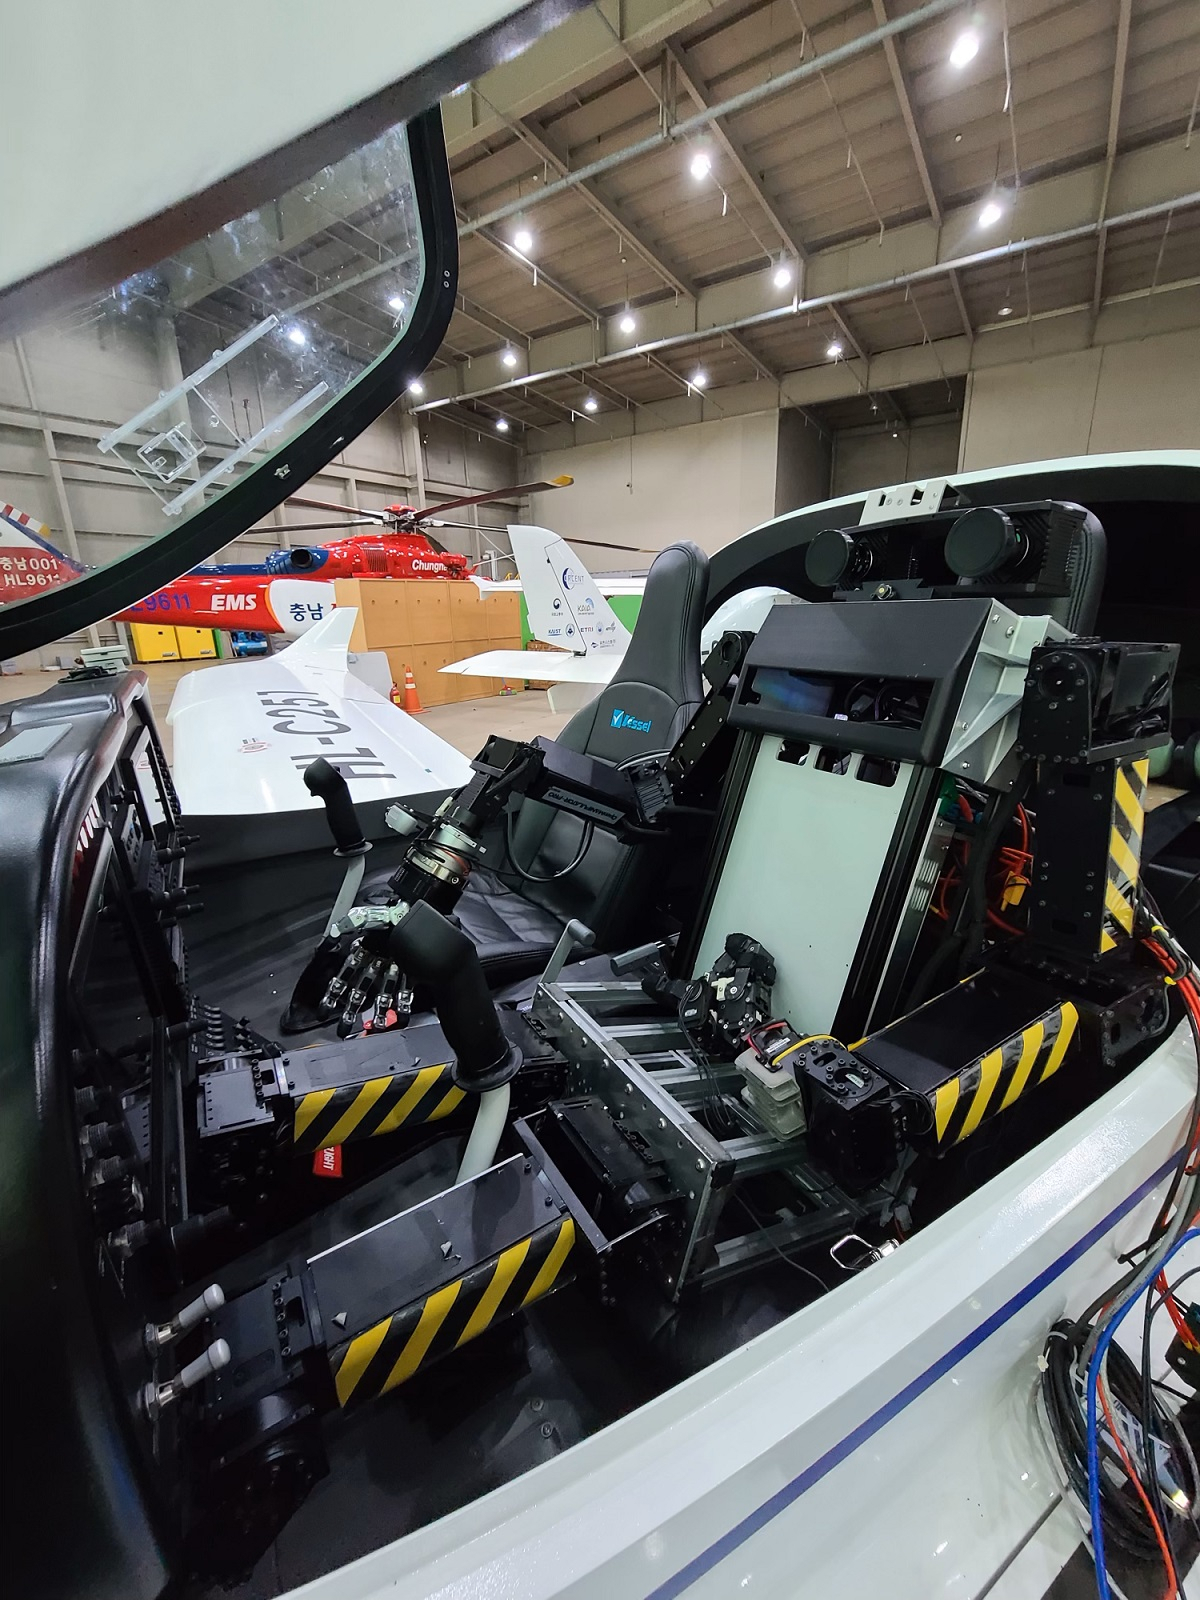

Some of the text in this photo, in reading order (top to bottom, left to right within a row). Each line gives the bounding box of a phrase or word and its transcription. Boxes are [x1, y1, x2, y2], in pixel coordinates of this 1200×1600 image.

[0, 556, 58, 571] 충남 001
[211, 594, 257, 611] EMS
[290, 603, 323, 622] 충남
